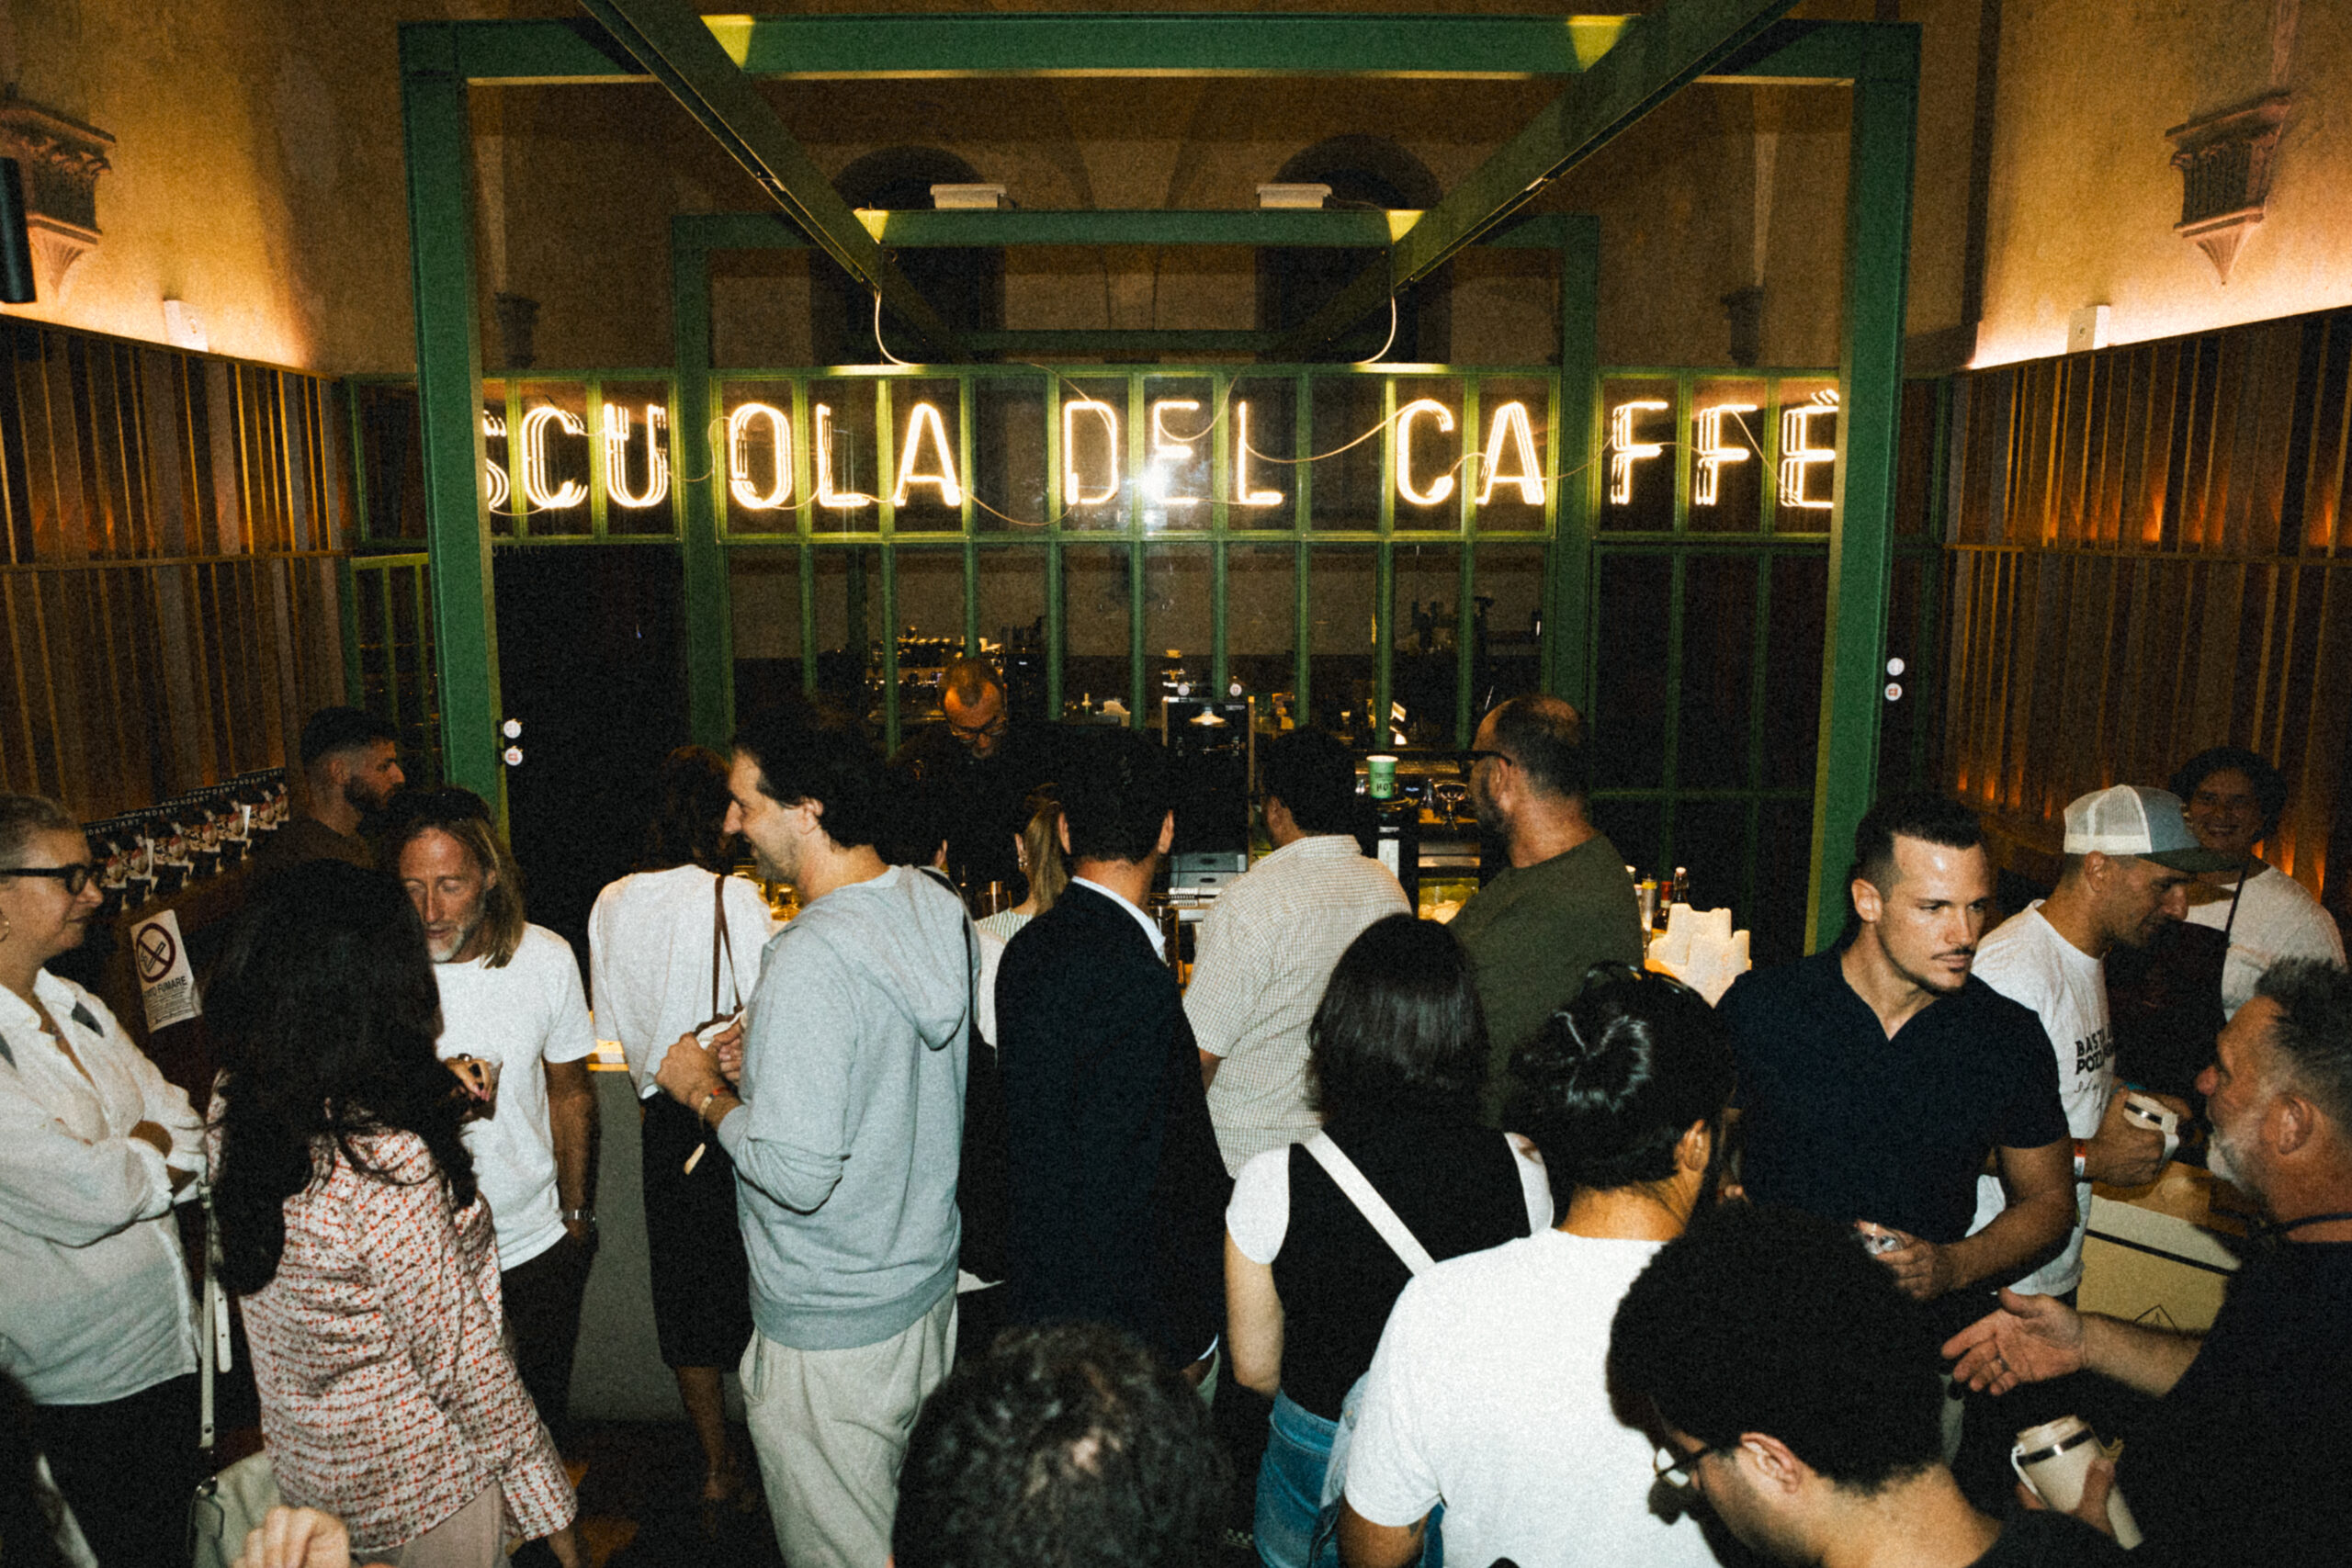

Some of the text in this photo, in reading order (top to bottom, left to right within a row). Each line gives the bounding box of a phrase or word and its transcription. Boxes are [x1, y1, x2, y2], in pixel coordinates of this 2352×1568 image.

[1062, 400, 1285, 506] DEL
[1396, 388, 1839, 509] CAFFÈ
[157, 976, 187, 993] FUMARE
